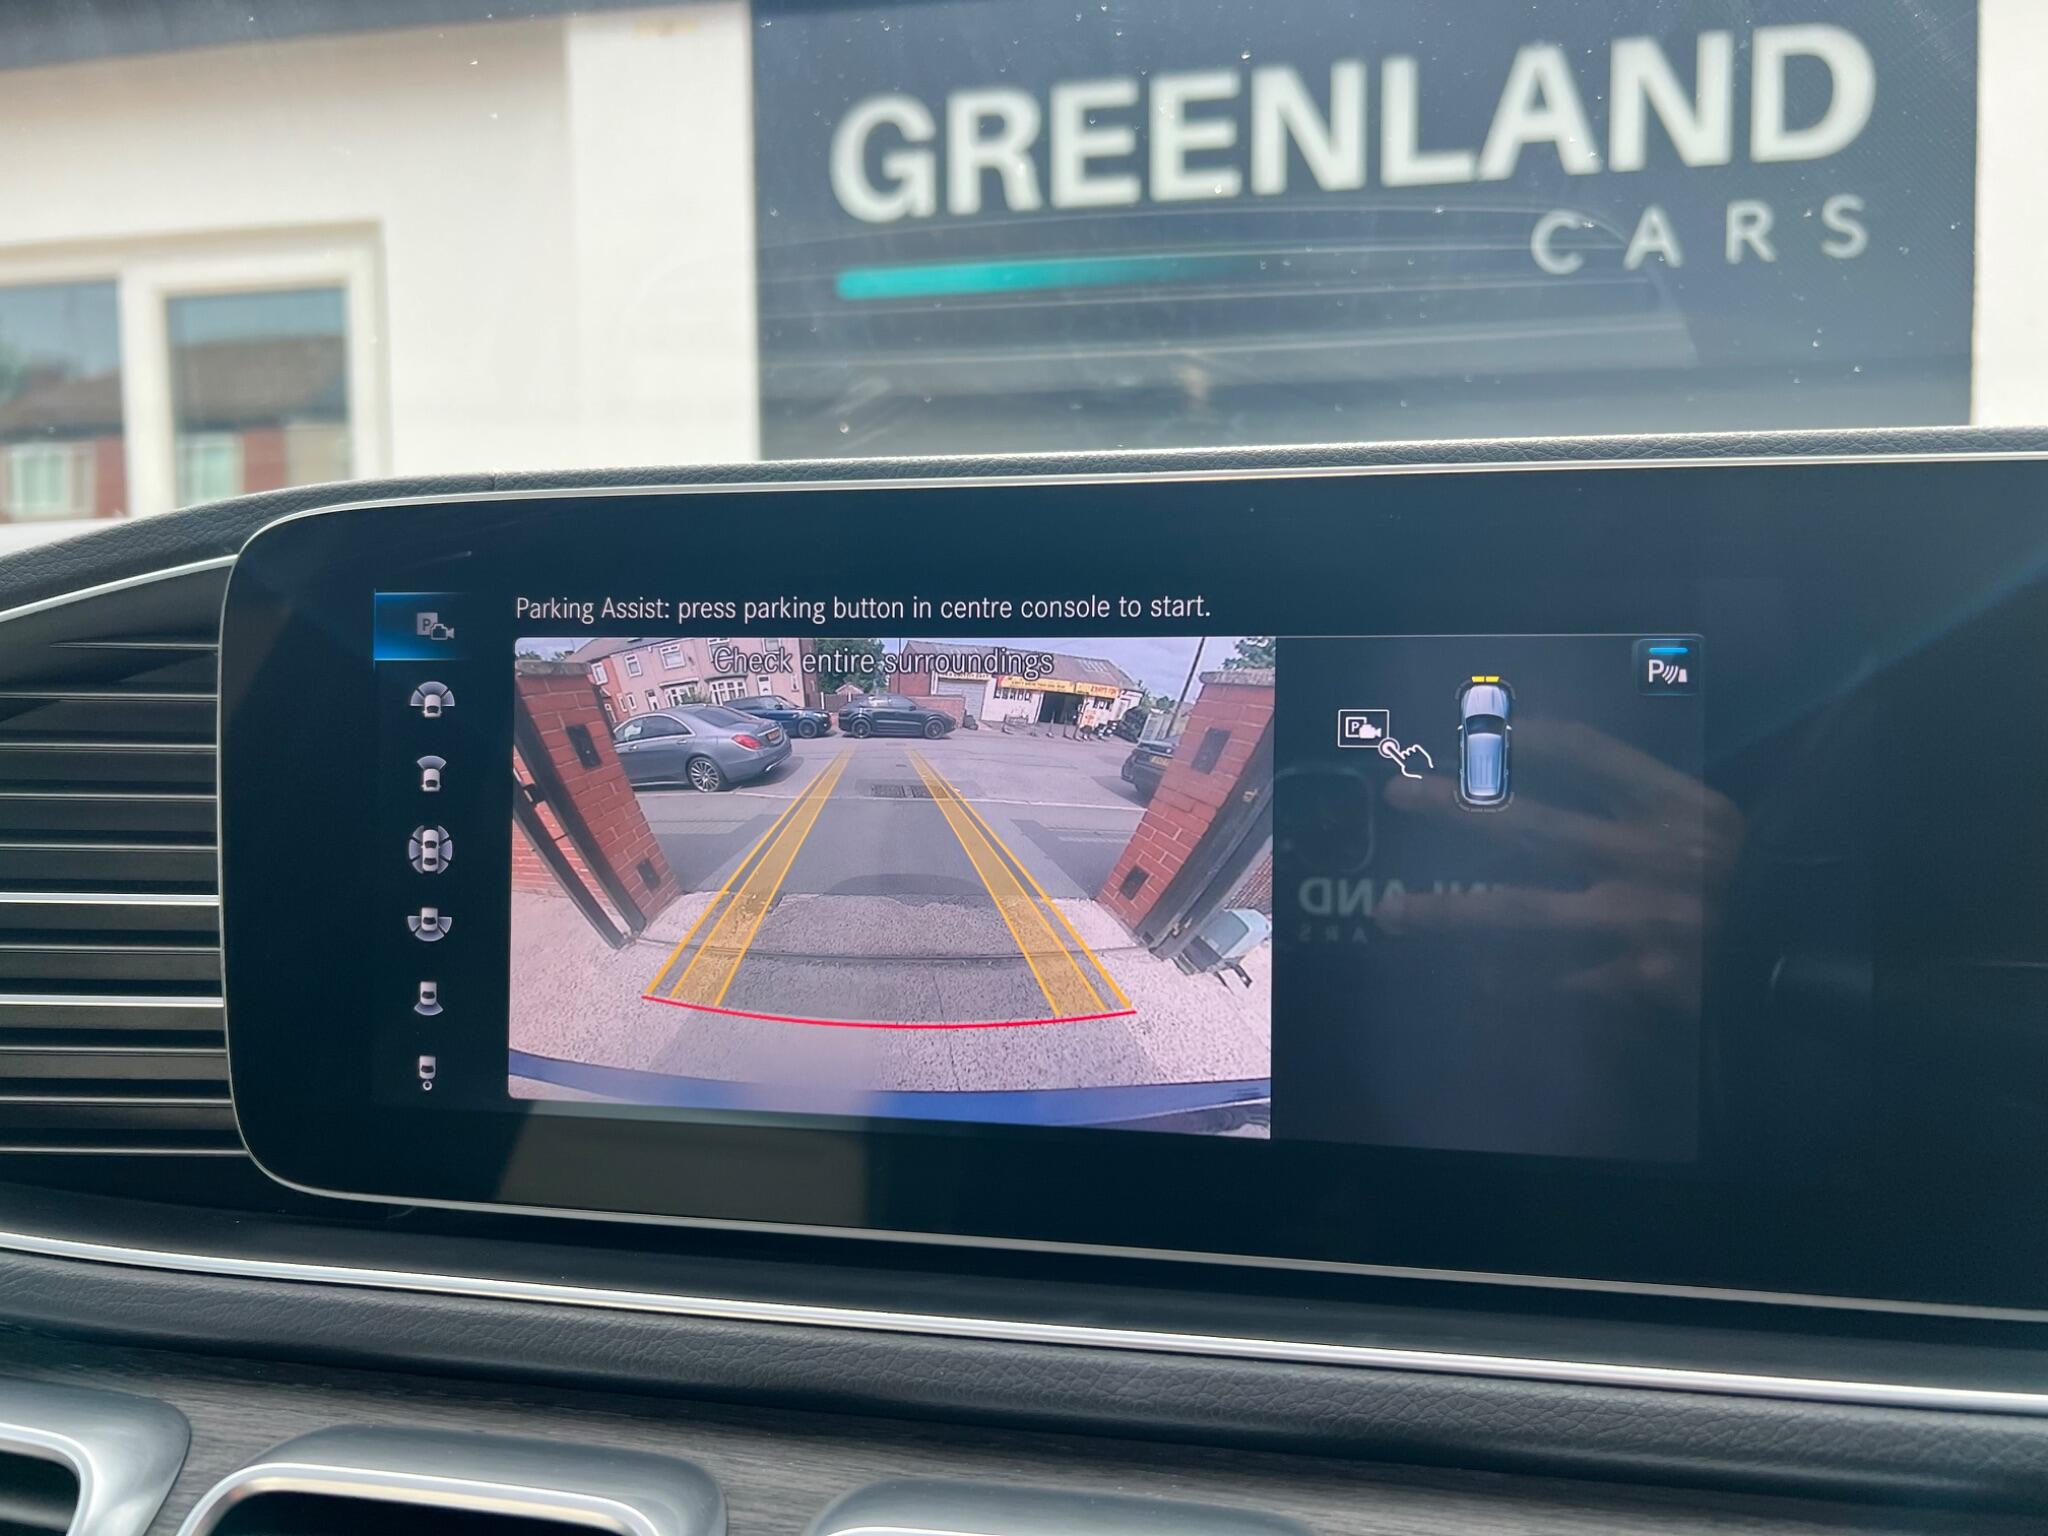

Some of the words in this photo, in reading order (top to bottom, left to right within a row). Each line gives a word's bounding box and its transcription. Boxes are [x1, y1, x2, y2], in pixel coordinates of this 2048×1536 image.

[829, 23, 1877, 222] GREENLAND
[1530, 194, 1869, 276] CARS
[516, 596, 595, 625] Parking
[600, 596, 670, 619] Assist:
[678, 601, 736, 625] press
[744, 595, 826, 625] parking
[833, 595, 904, 619] button
[913, 595, 932, 619] in
[940, 597, 1013, 619] centre
[1020, 594, 1111, 619] console
[1118, 596, 1142, 619] to
[1150, 595, 1212, 618] start.
[713, 647, 793, 674] Check
[802, 648, 877, 675] entire
[884, 648, 1054, 679] surroundings
